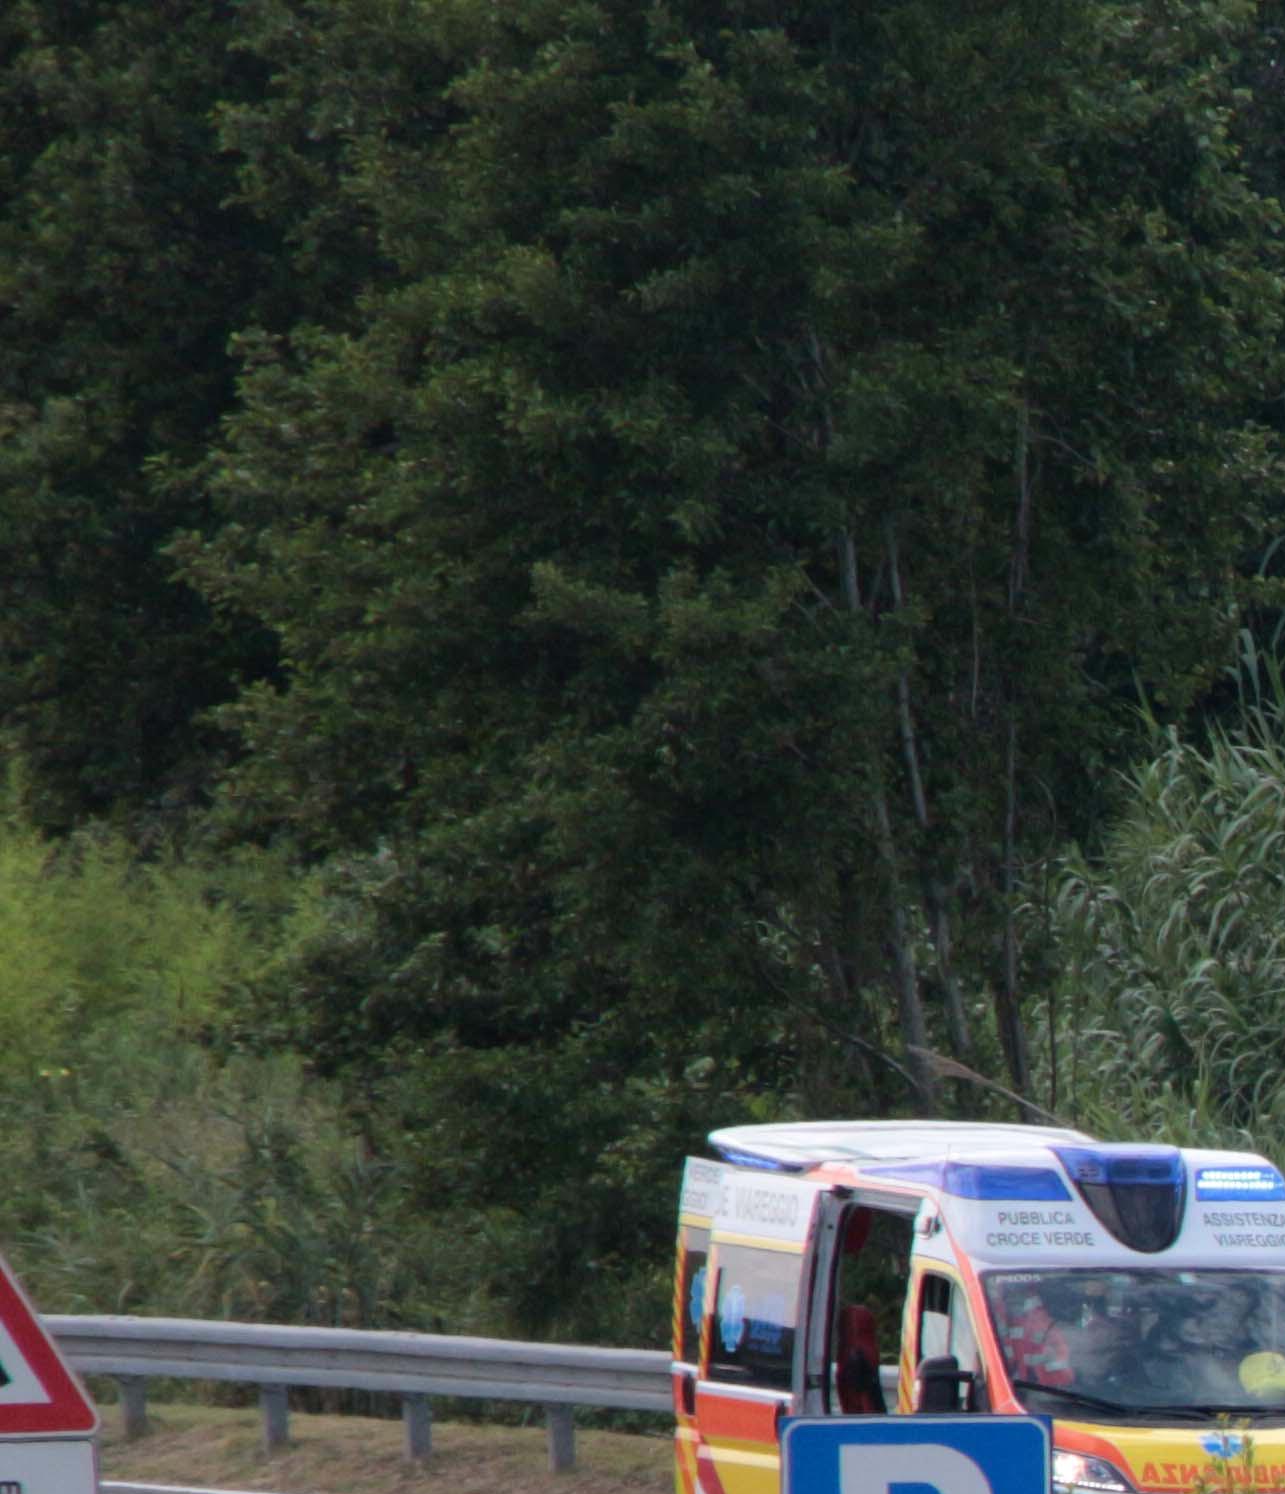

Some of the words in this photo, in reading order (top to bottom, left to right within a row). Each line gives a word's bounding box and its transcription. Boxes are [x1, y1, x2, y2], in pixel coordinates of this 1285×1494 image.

[735, 1184, 800, 1228] VIAREGGIO
[997, 1211, 1076, 1226] PUBBLICA
[985, 1232, 1046, 1247] CROCE
[1047, 1231, 1095, 1247] VERDE
